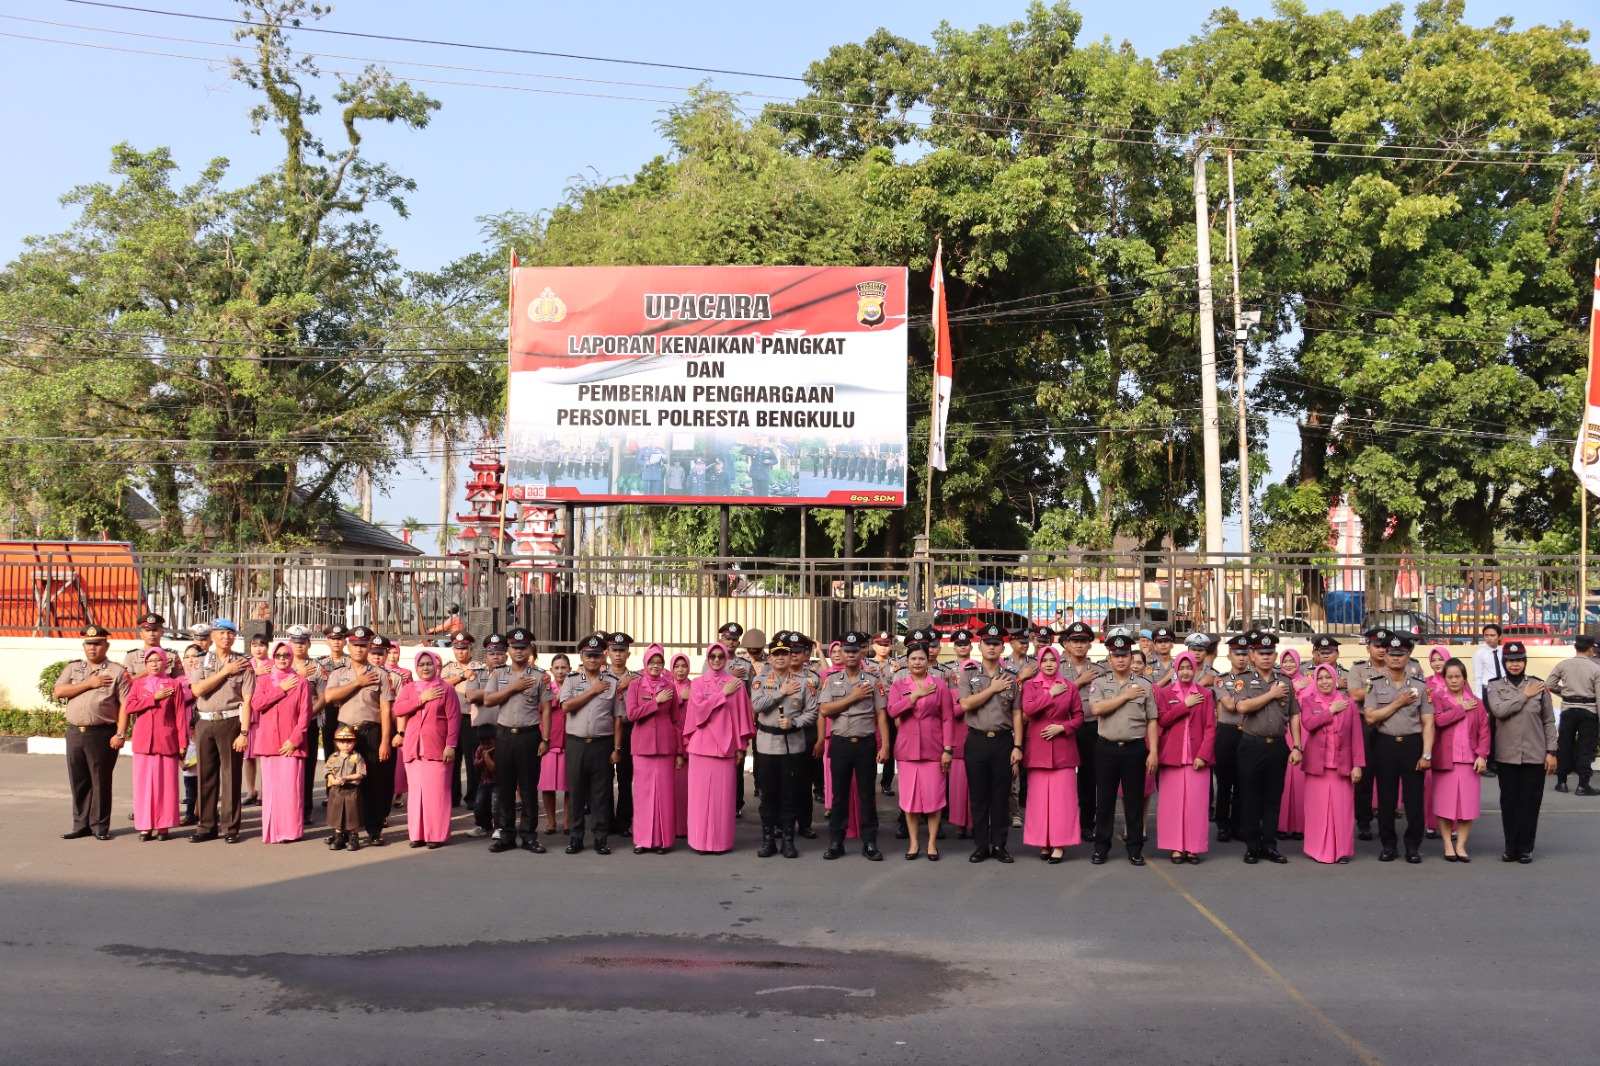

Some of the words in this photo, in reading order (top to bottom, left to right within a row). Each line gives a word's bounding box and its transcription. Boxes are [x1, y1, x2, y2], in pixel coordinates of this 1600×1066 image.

[645, 295, 771, 319] UPACARA
[569, 336, 655, 355] LAPORAN
[661, 336, 755, 355] KENAIKAN
[761, 337, 846, 355] PANGKAT
[686, 361, 725, 378] DAN
[578, 385, 686, 402] PEMBERIAN
[693, 385, 834, 403] PENGHARGAAN
[556, 409, 651, 426] PERSONEL
[658, 409, 749, 427] POLRESTA
[756, 410, 855, 428] BENGKULU
[873, 495, 896, 503] SDM
